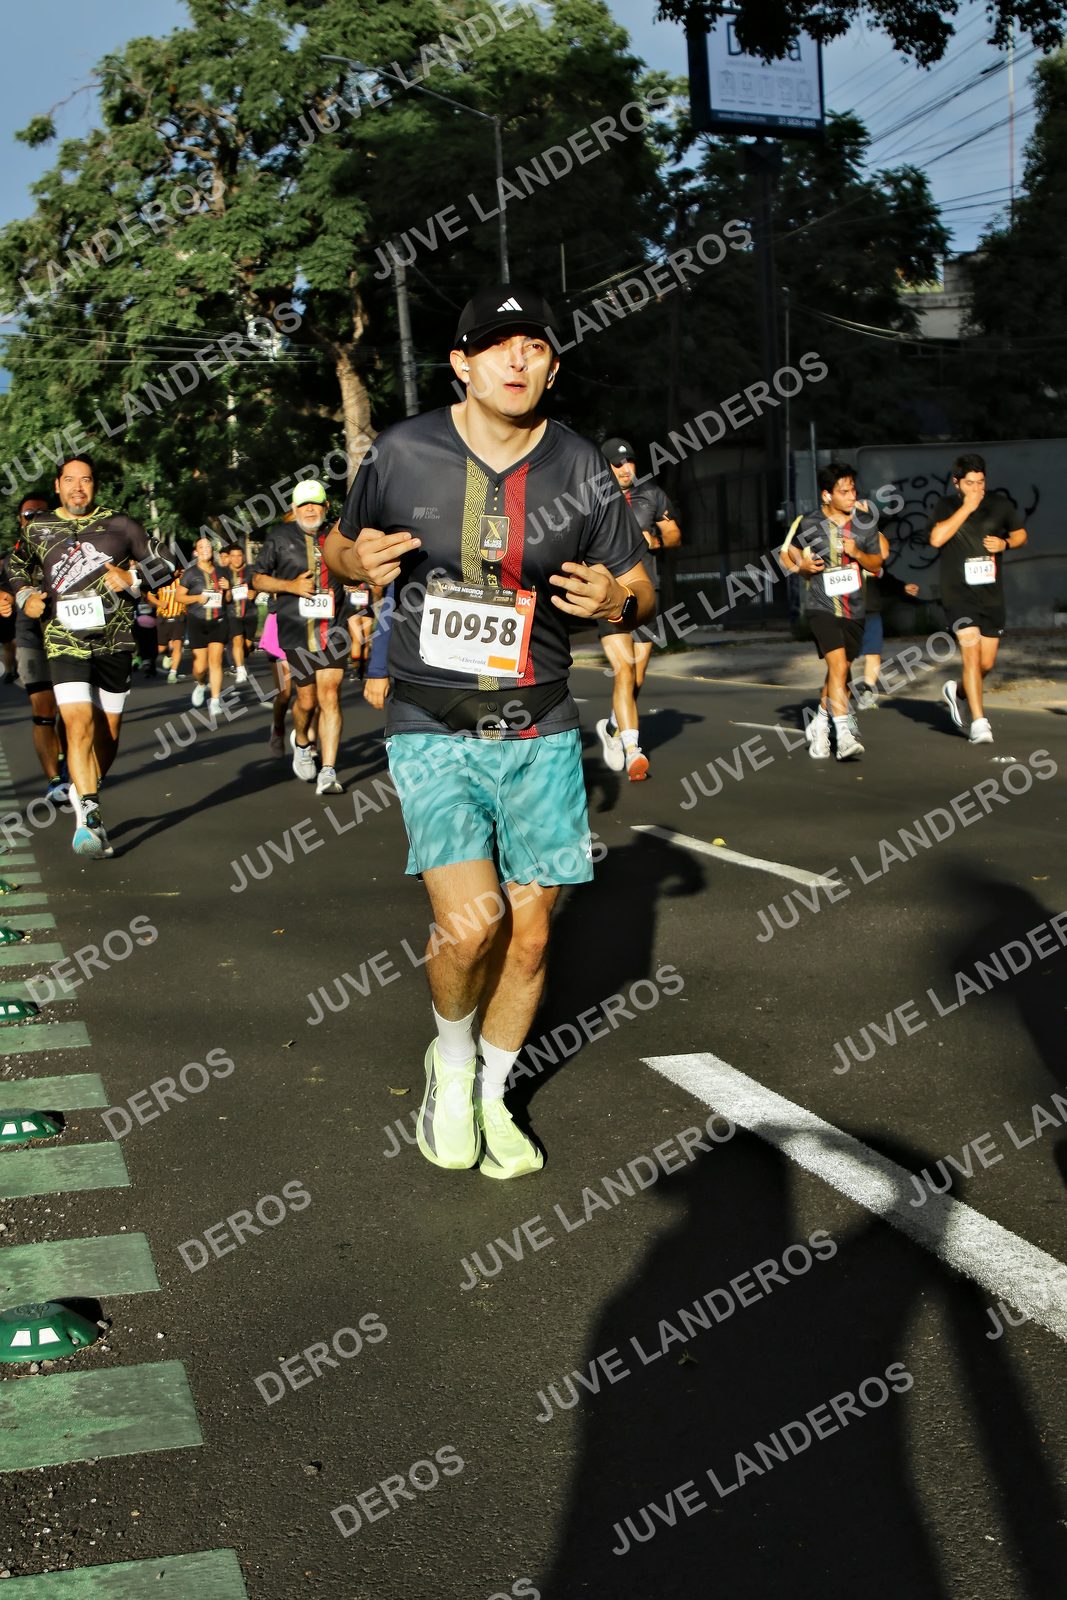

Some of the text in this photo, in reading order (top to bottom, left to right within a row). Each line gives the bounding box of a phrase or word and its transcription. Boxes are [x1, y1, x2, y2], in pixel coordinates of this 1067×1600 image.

[829, 574, 853, 585] 8946
[64, 602, 94, 617] 1095
[429, 608, 517, 646] 10958
